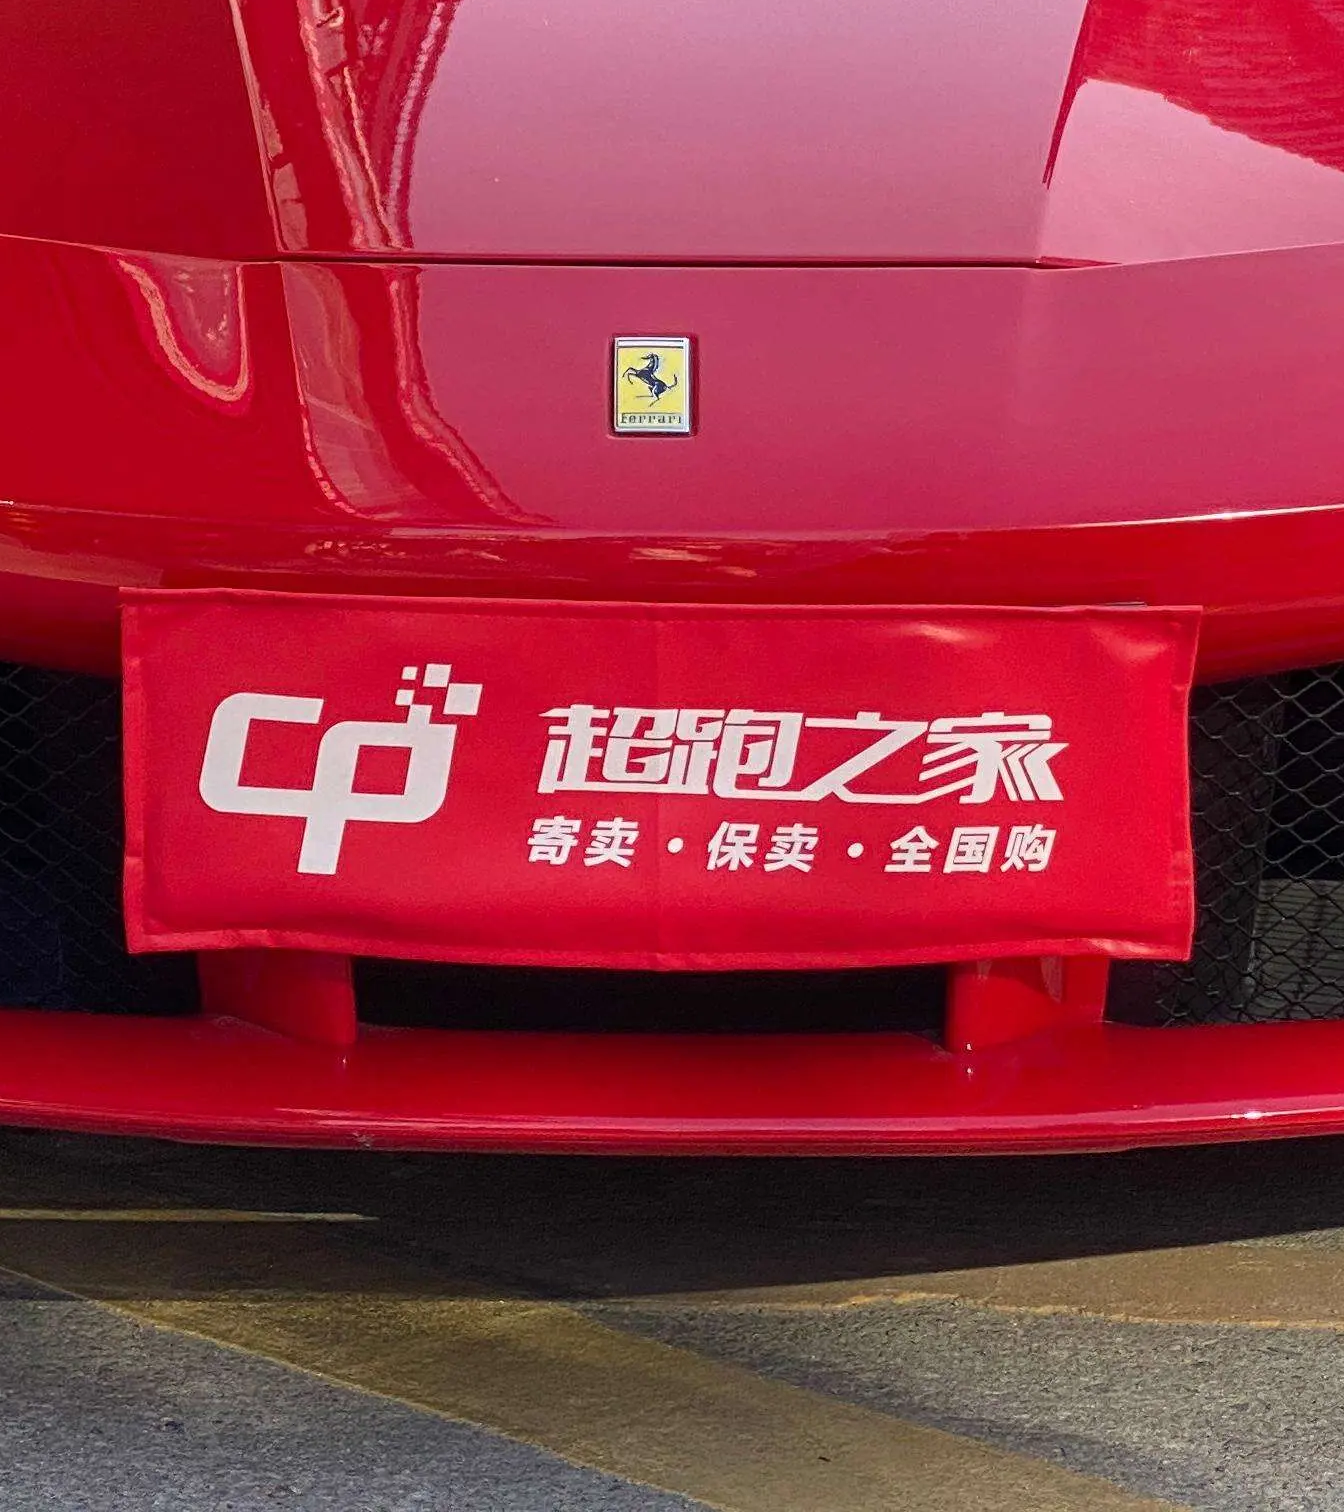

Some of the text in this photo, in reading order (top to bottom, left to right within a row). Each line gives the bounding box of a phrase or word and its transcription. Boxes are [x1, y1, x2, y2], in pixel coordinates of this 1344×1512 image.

[619, 412, 683, 425] Ferrari
[538, 704, 1068, 805] 超跑之家
